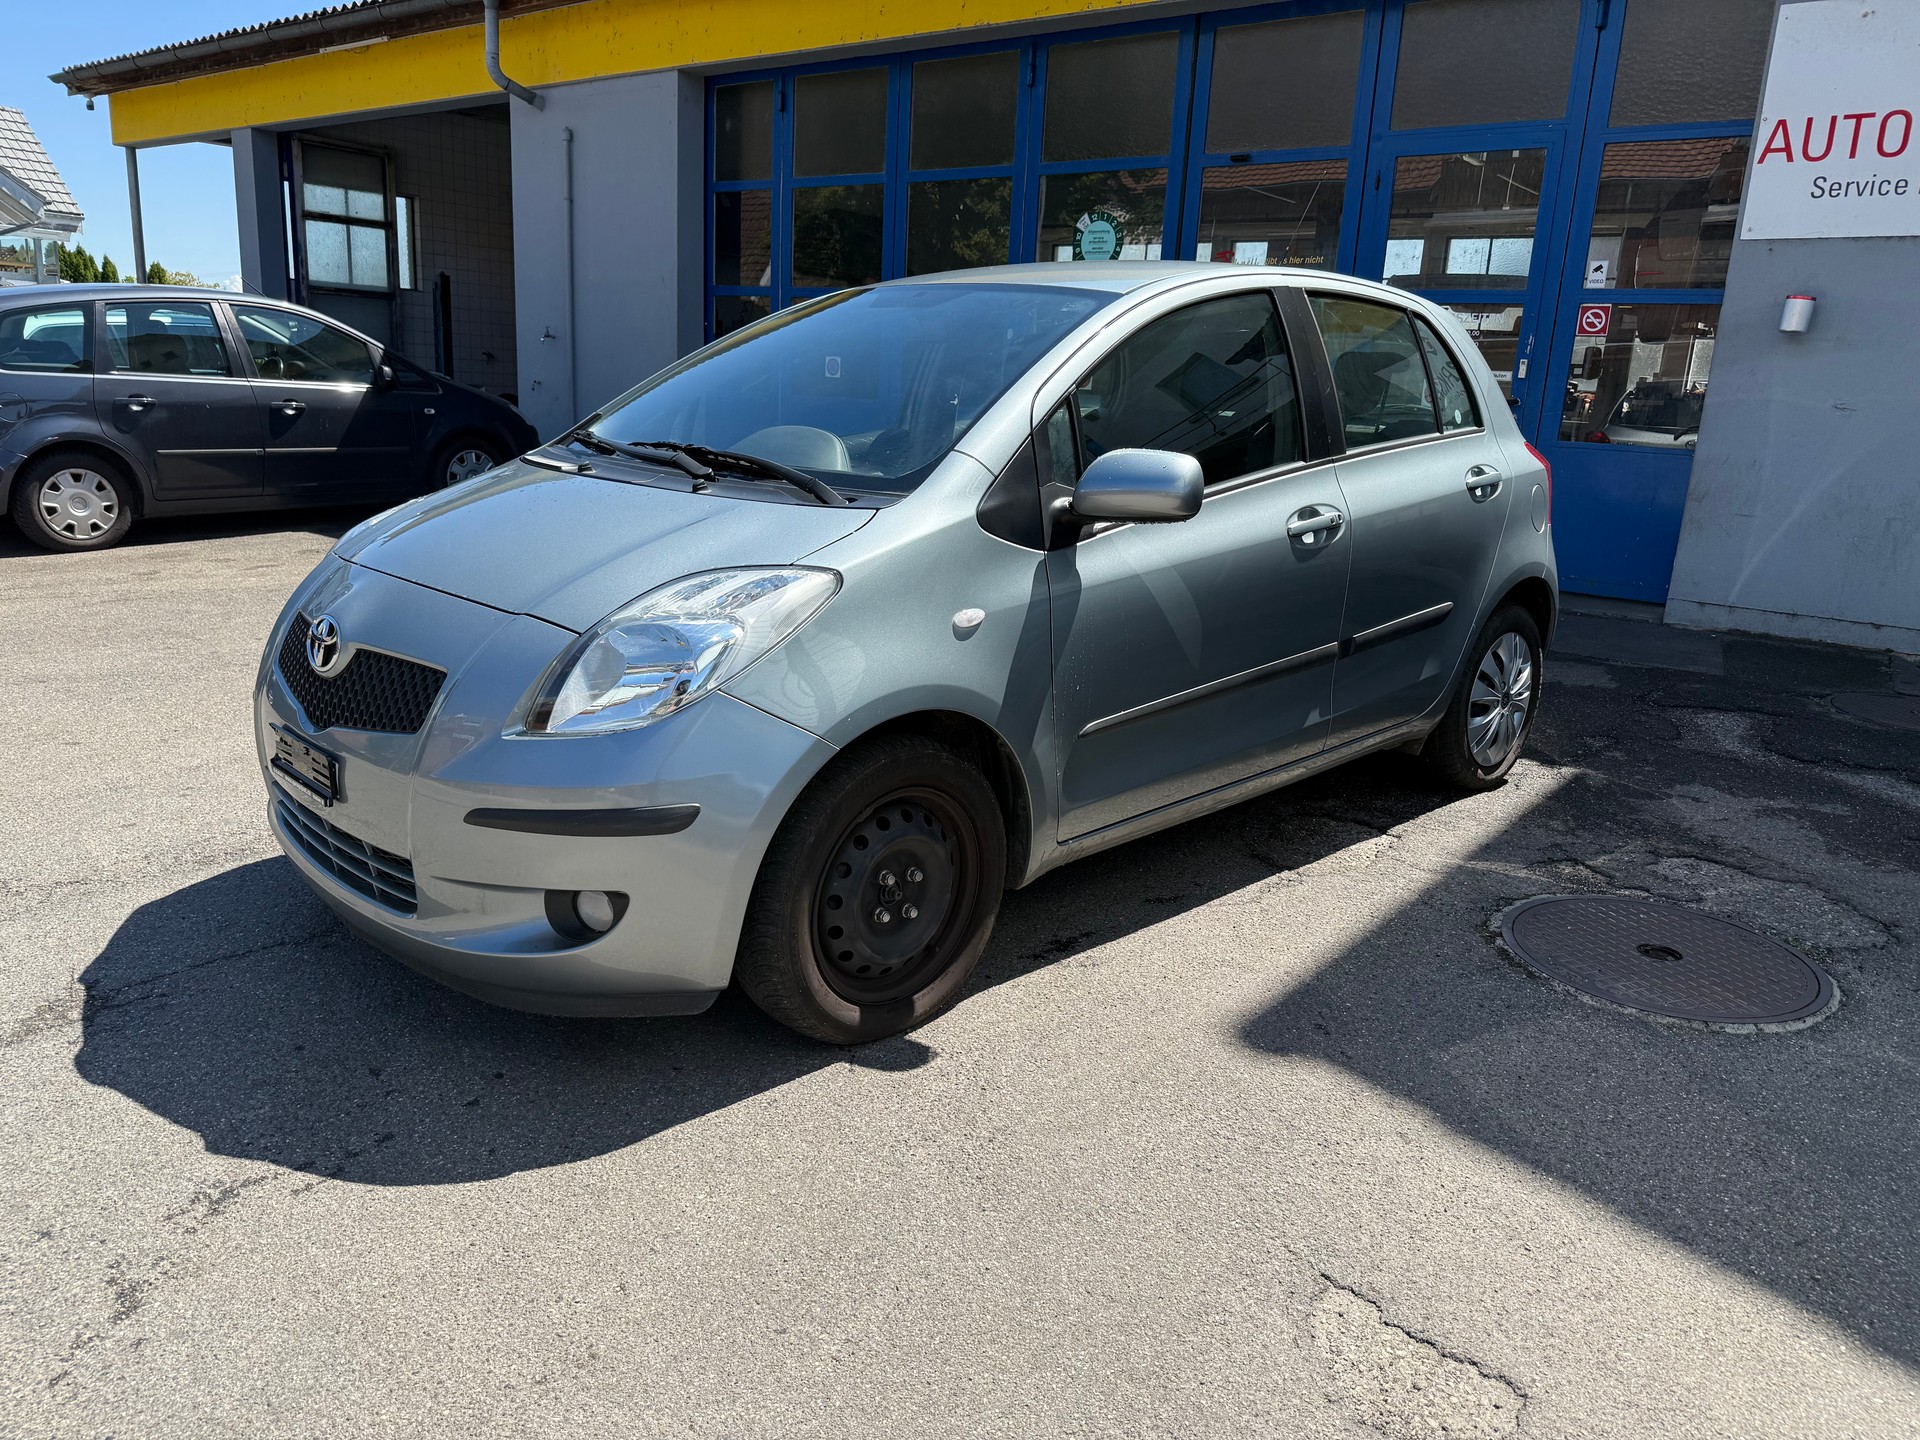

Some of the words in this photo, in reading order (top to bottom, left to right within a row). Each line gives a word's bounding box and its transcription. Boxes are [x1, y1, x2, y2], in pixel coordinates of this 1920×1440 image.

[1757, 109, 1913, 164] AUTO
[1810, 173, 1909, 199] Service
[1288, 256, 1303, 264] hier
[1305, 255, 1324, 264] nicht
